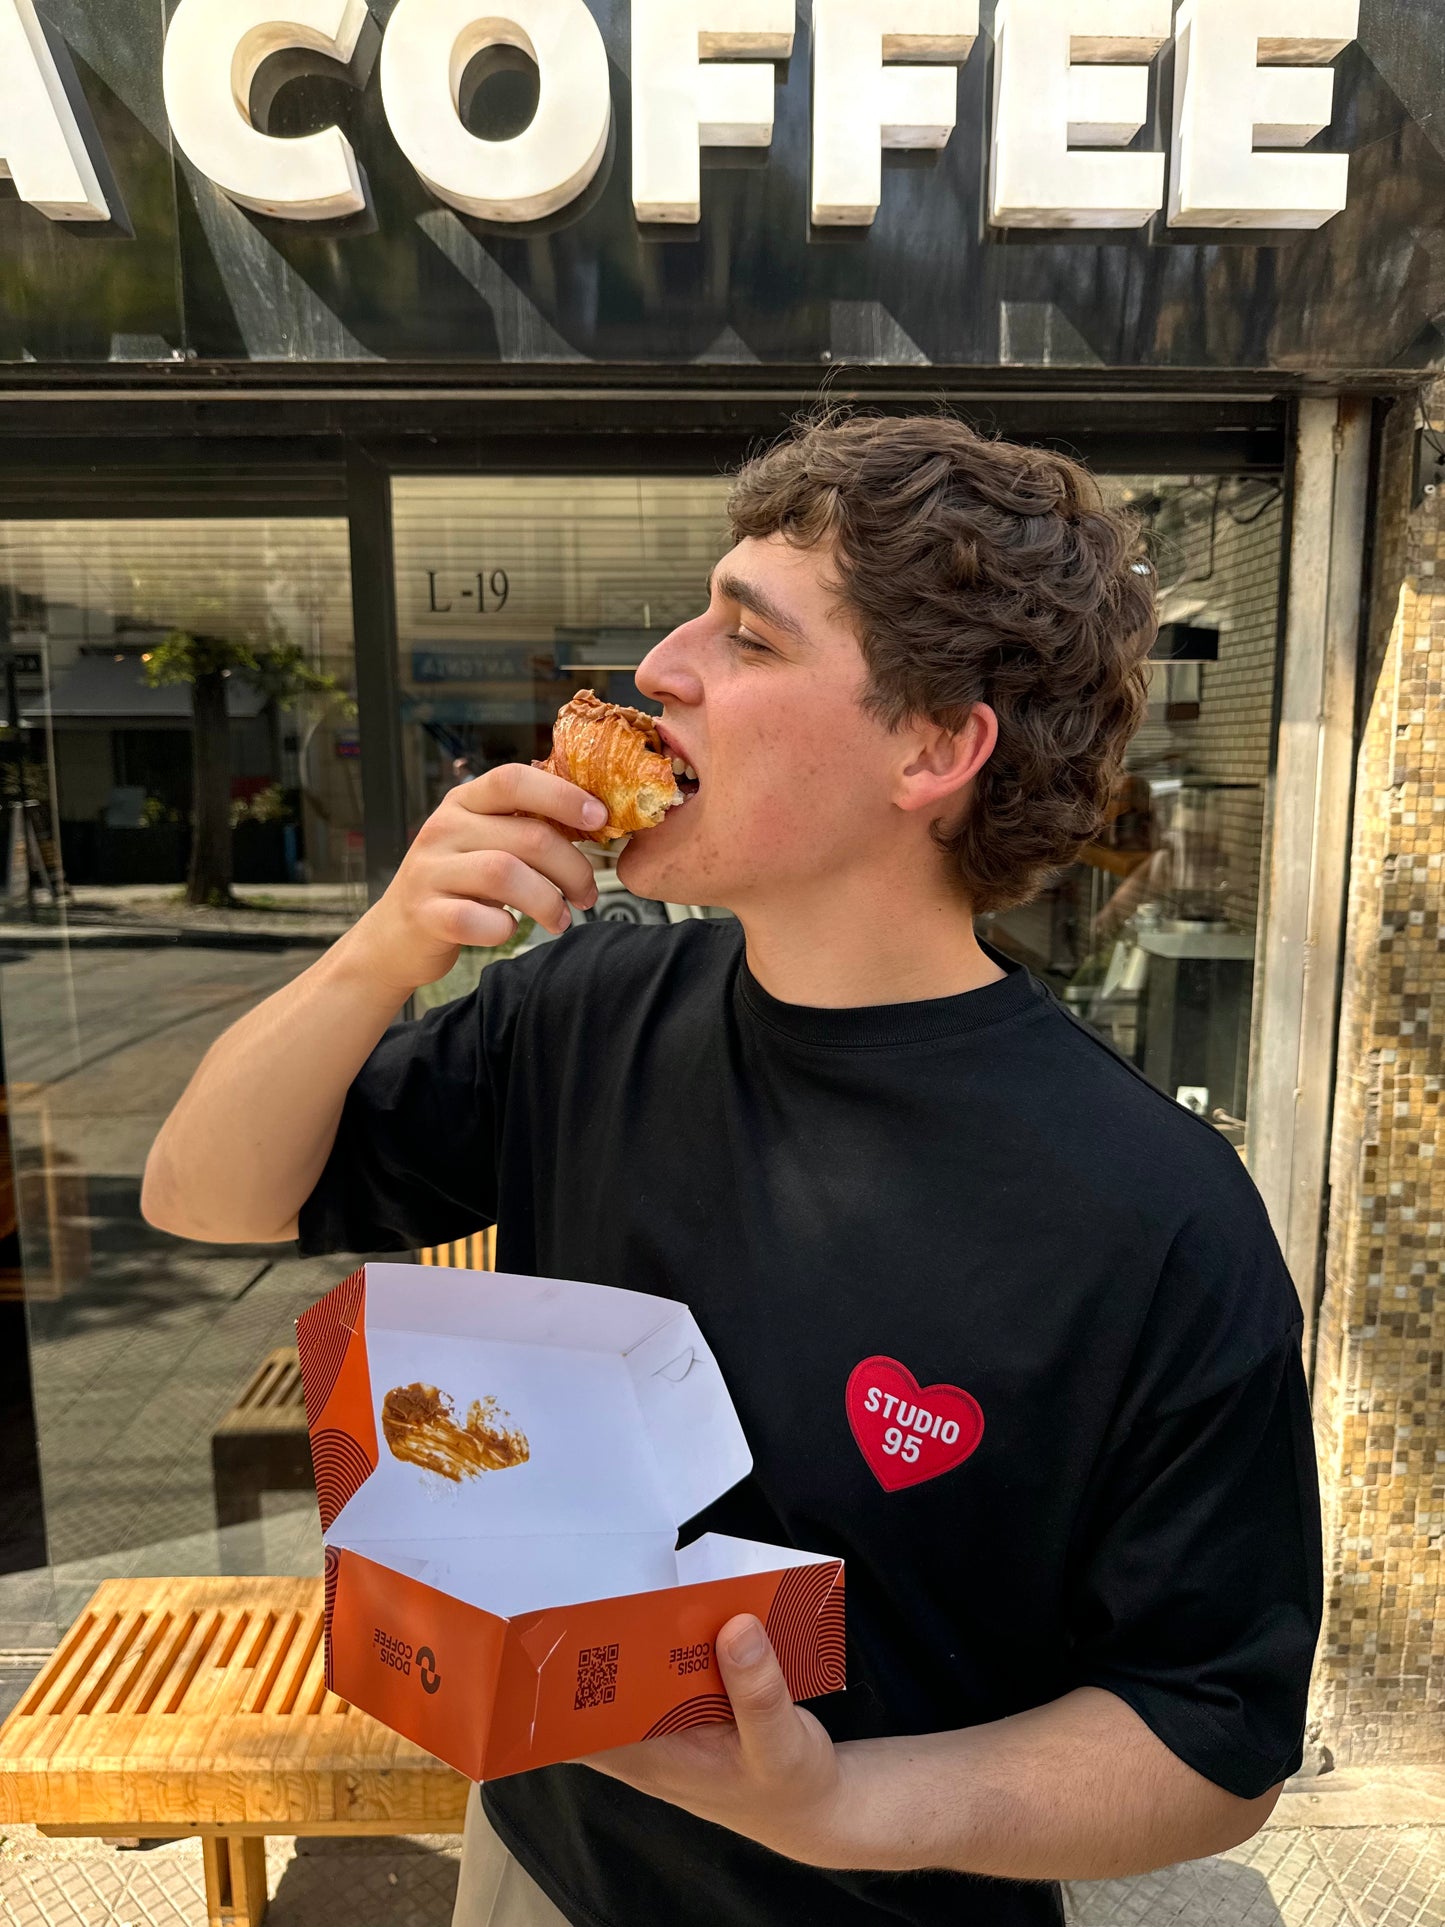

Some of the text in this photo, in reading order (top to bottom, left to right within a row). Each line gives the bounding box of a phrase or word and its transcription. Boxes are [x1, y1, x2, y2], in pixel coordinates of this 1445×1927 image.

[162, 0, 1360, 230] COFFEE
[863, 1386, 960, 1445] STUDIO
[881, 1427, 923, 1464] 95
[373, 1628, 413, 1660] COFFEE
[669, 1642, 711, 1663] COFFEE
[379, 1648, 411, 1676] DOSIS
[677, 1656, 709, 1676] DOSIS
